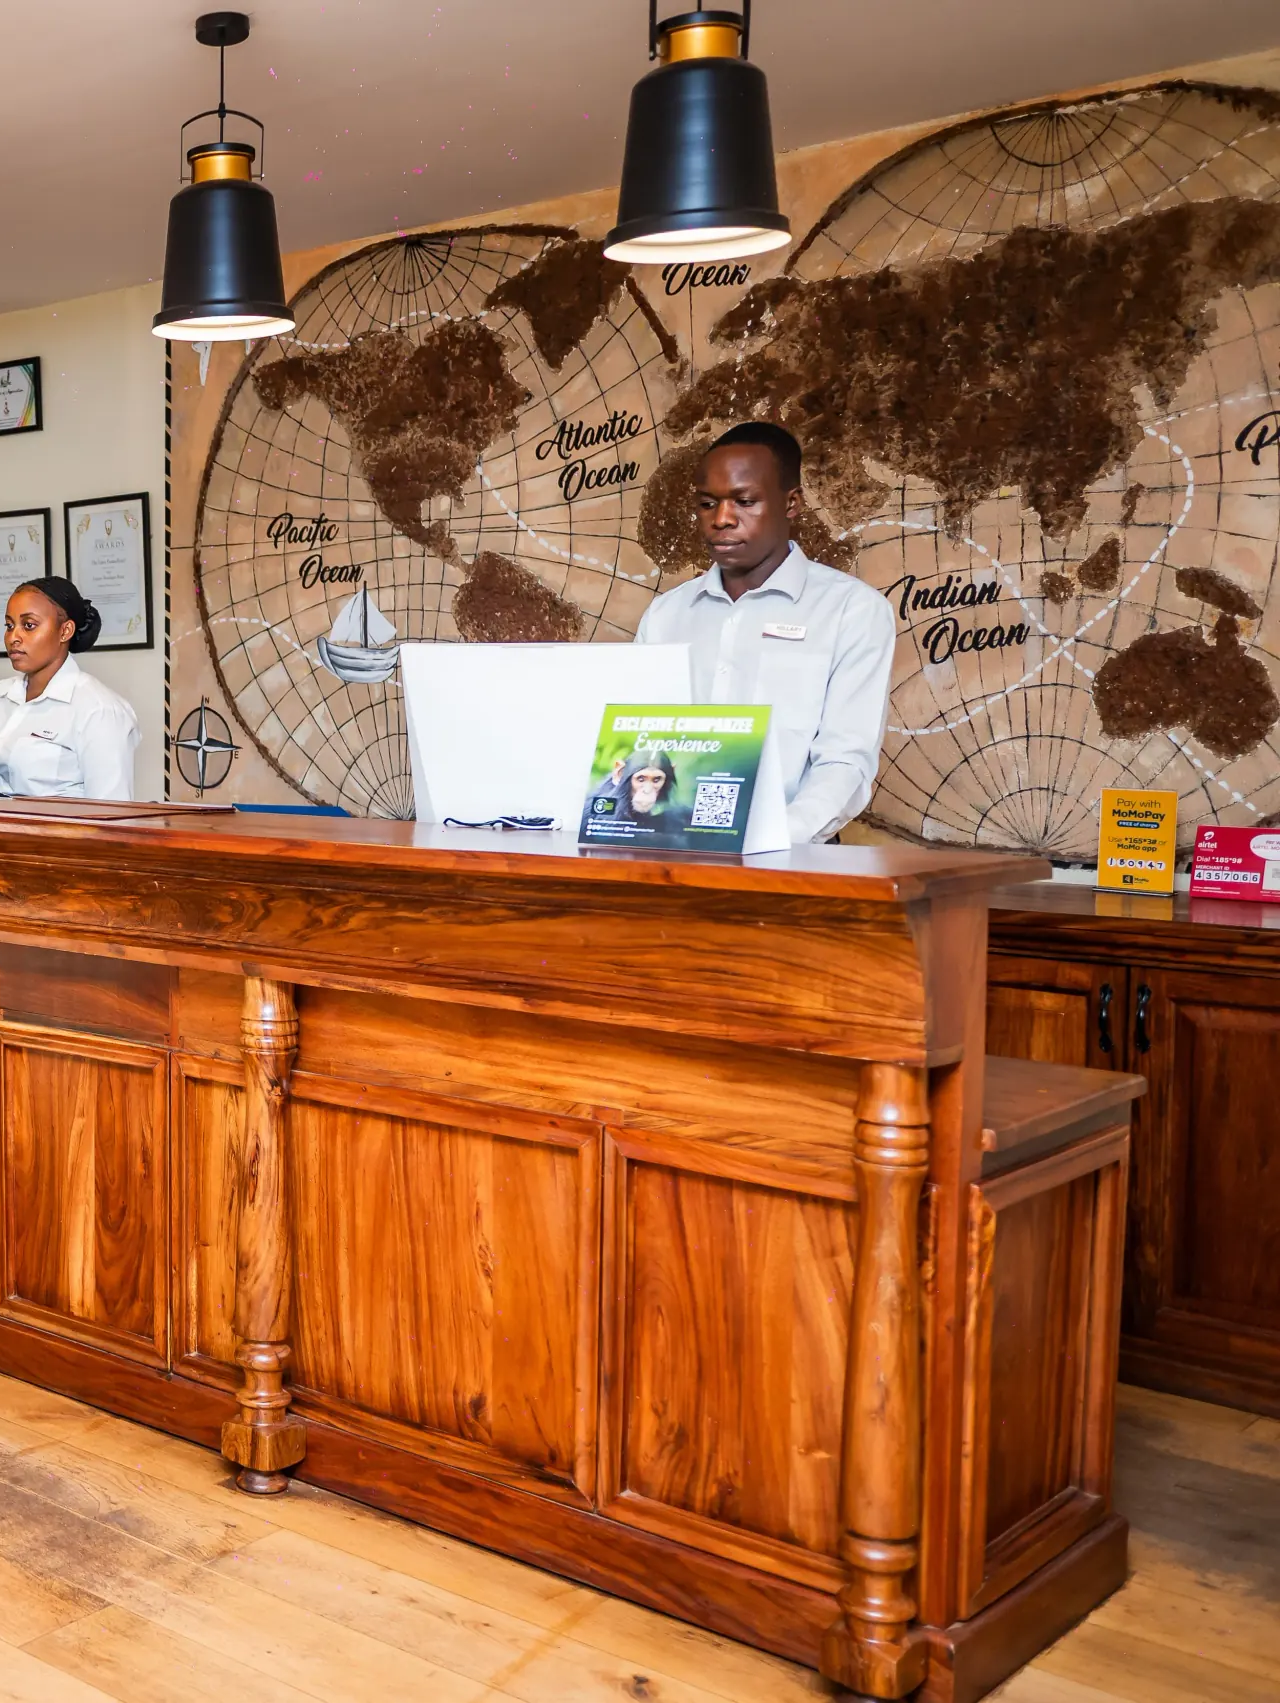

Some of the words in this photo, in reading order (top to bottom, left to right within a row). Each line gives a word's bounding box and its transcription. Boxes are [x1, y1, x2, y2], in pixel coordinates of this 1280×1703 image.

[662, 263, 751, 295] Ocean
[536, 410, 642, 460] Atlantic
[558, 459, 640, 500] Ocean
[267, 513, 339, 550] Pacific
[299, 554, 364, 589] Ocean
[885, 575, 1002, 620] Indian
[922, 617, 1030, 664] Ocean
[234, 751, 239, 759] E
[633, 732, 722, 760] Experience
[195, 789, 200, 798] S
[1116, 797, 1136, 809] Pay
[1139, 800, 1161, 808] with
[1112, 809, 1165, 821] MoMoPay
[1117, 843, 1140, 851] MoMo
[1198, 841, 1217, 849] airtel
